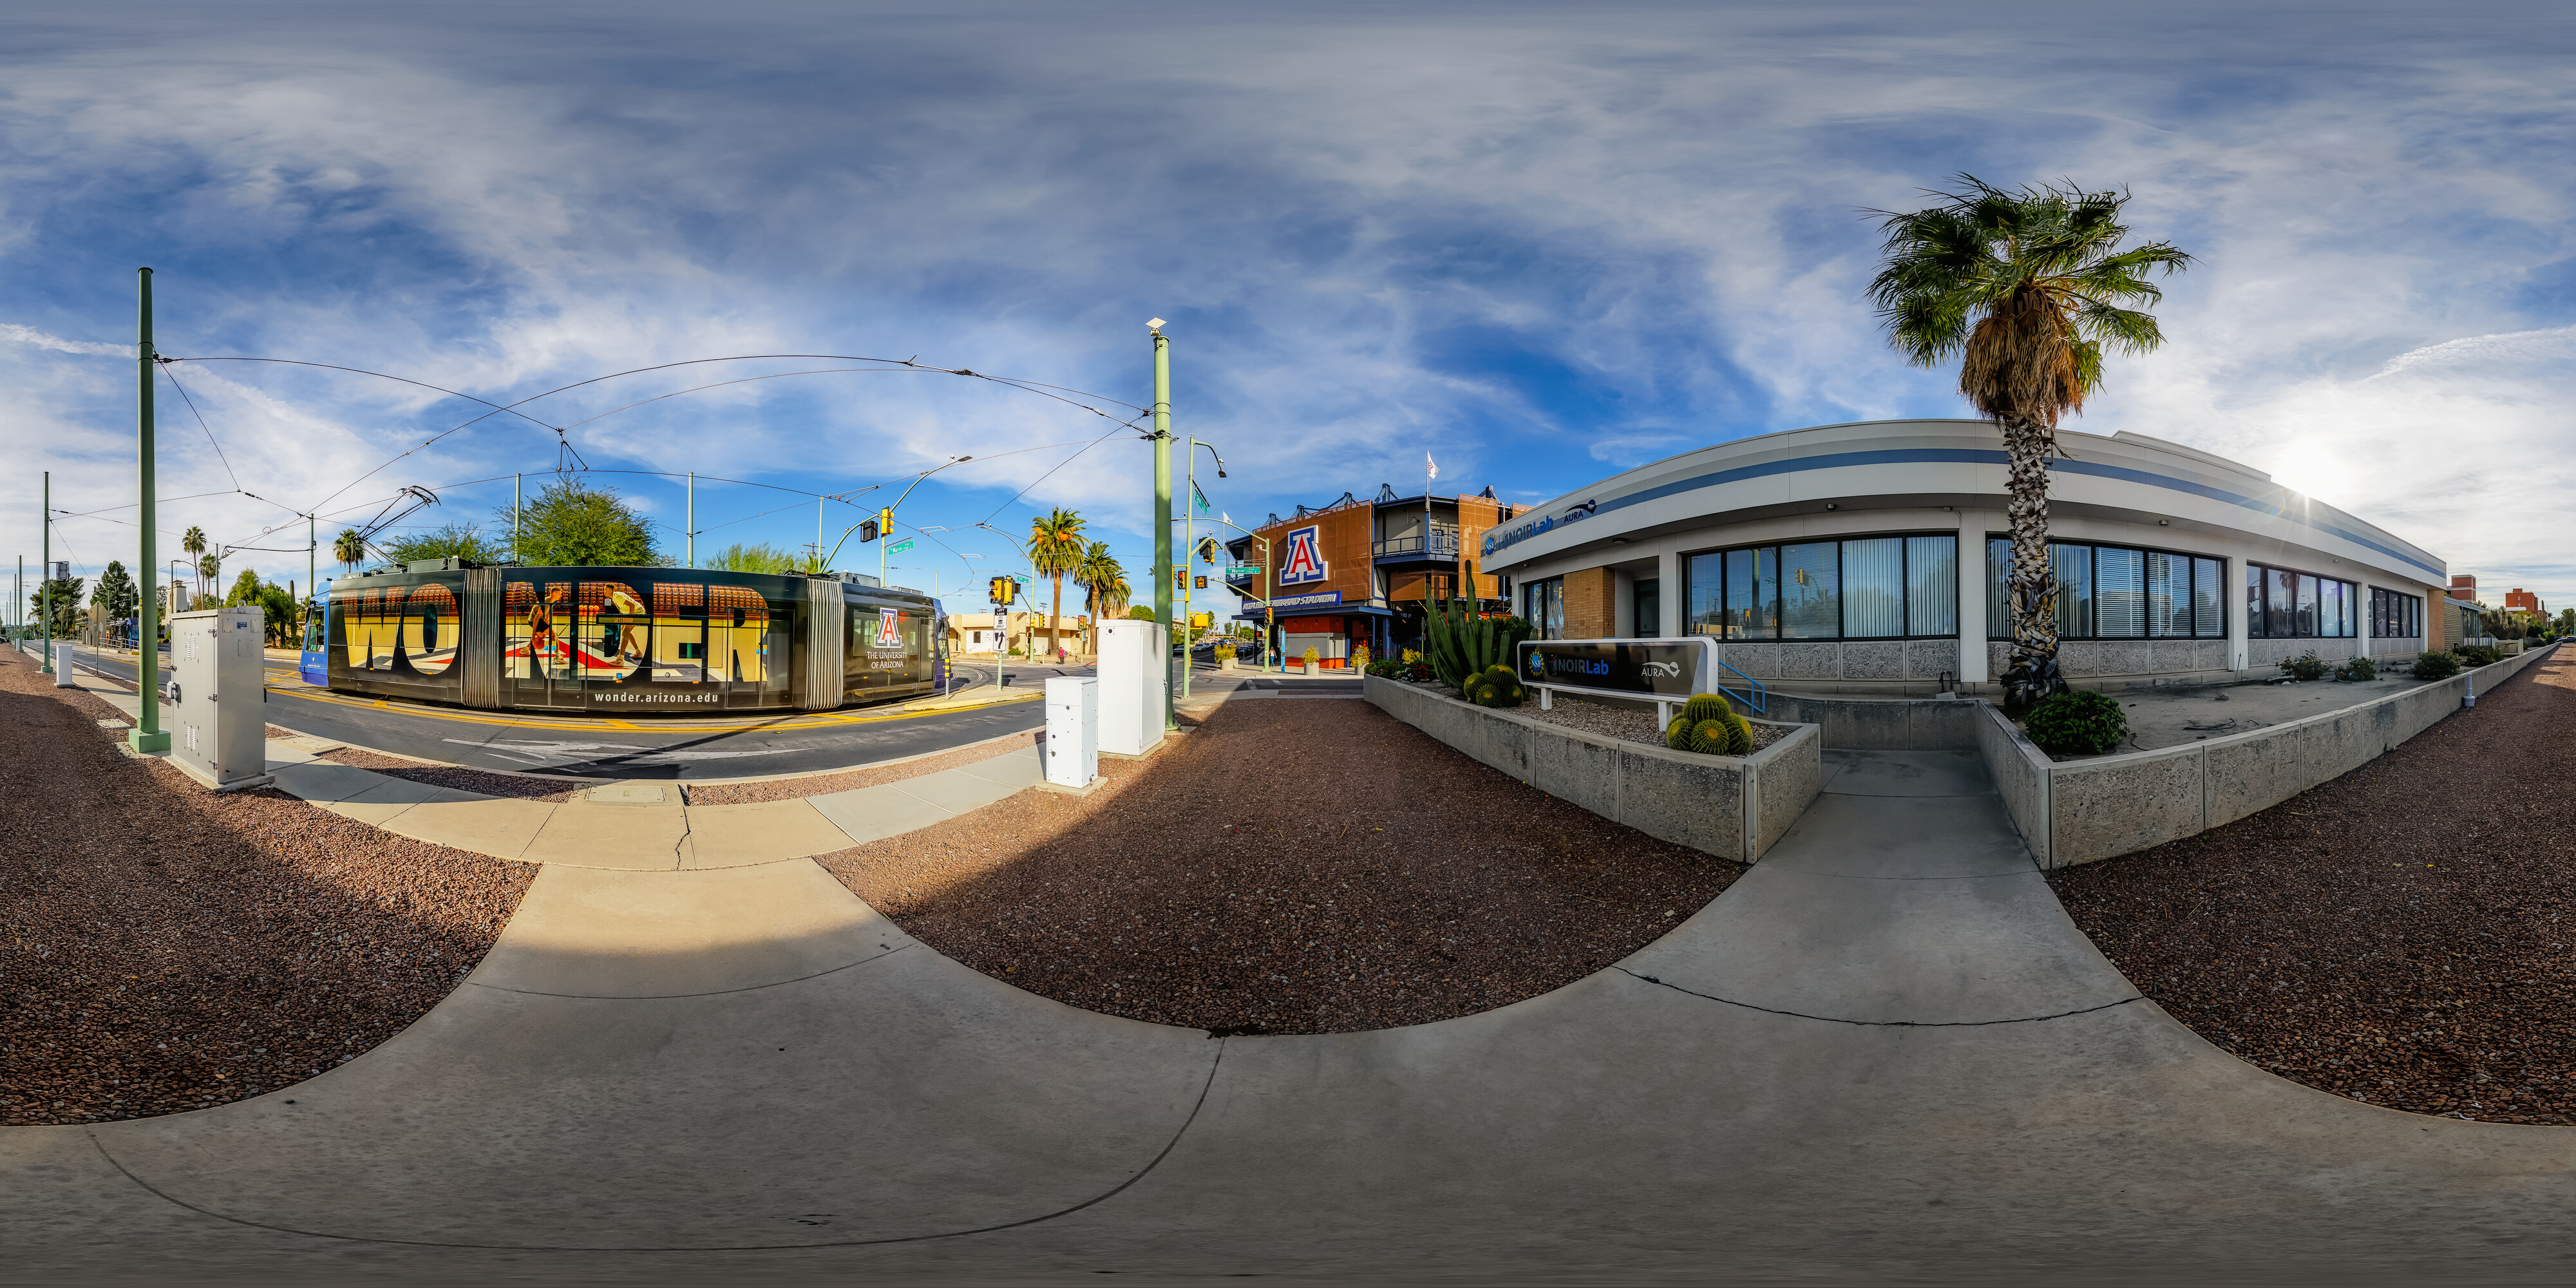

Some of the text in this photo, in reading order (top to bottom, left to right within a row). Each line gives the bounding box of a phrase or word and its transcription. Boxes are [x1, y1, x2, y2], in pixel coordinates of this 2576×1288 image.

[1564, 510, 1584, 524] AURA
[1508, 516, 1553, 544] NOIRLab
[1486, 541, 1495, 550] NSF
[1280, 525, 1328, 586] A
[1255, 597, 1300, 609] HILENBRAND
[1300, 594, 1337, 605] STADIUM
[341, 582, 769, 682] WONDER
[874, 607, 902, 648] A
[867, 651, 908, 659] THE UNIVERSITY
[880, 660, 904, 668] ARIZONA
[1558, 659, 1609, 675] NOIRLab
[1642, 668, 1665, 677] AURA
[595, 692, 718, 703] wonder.arizona.edu
